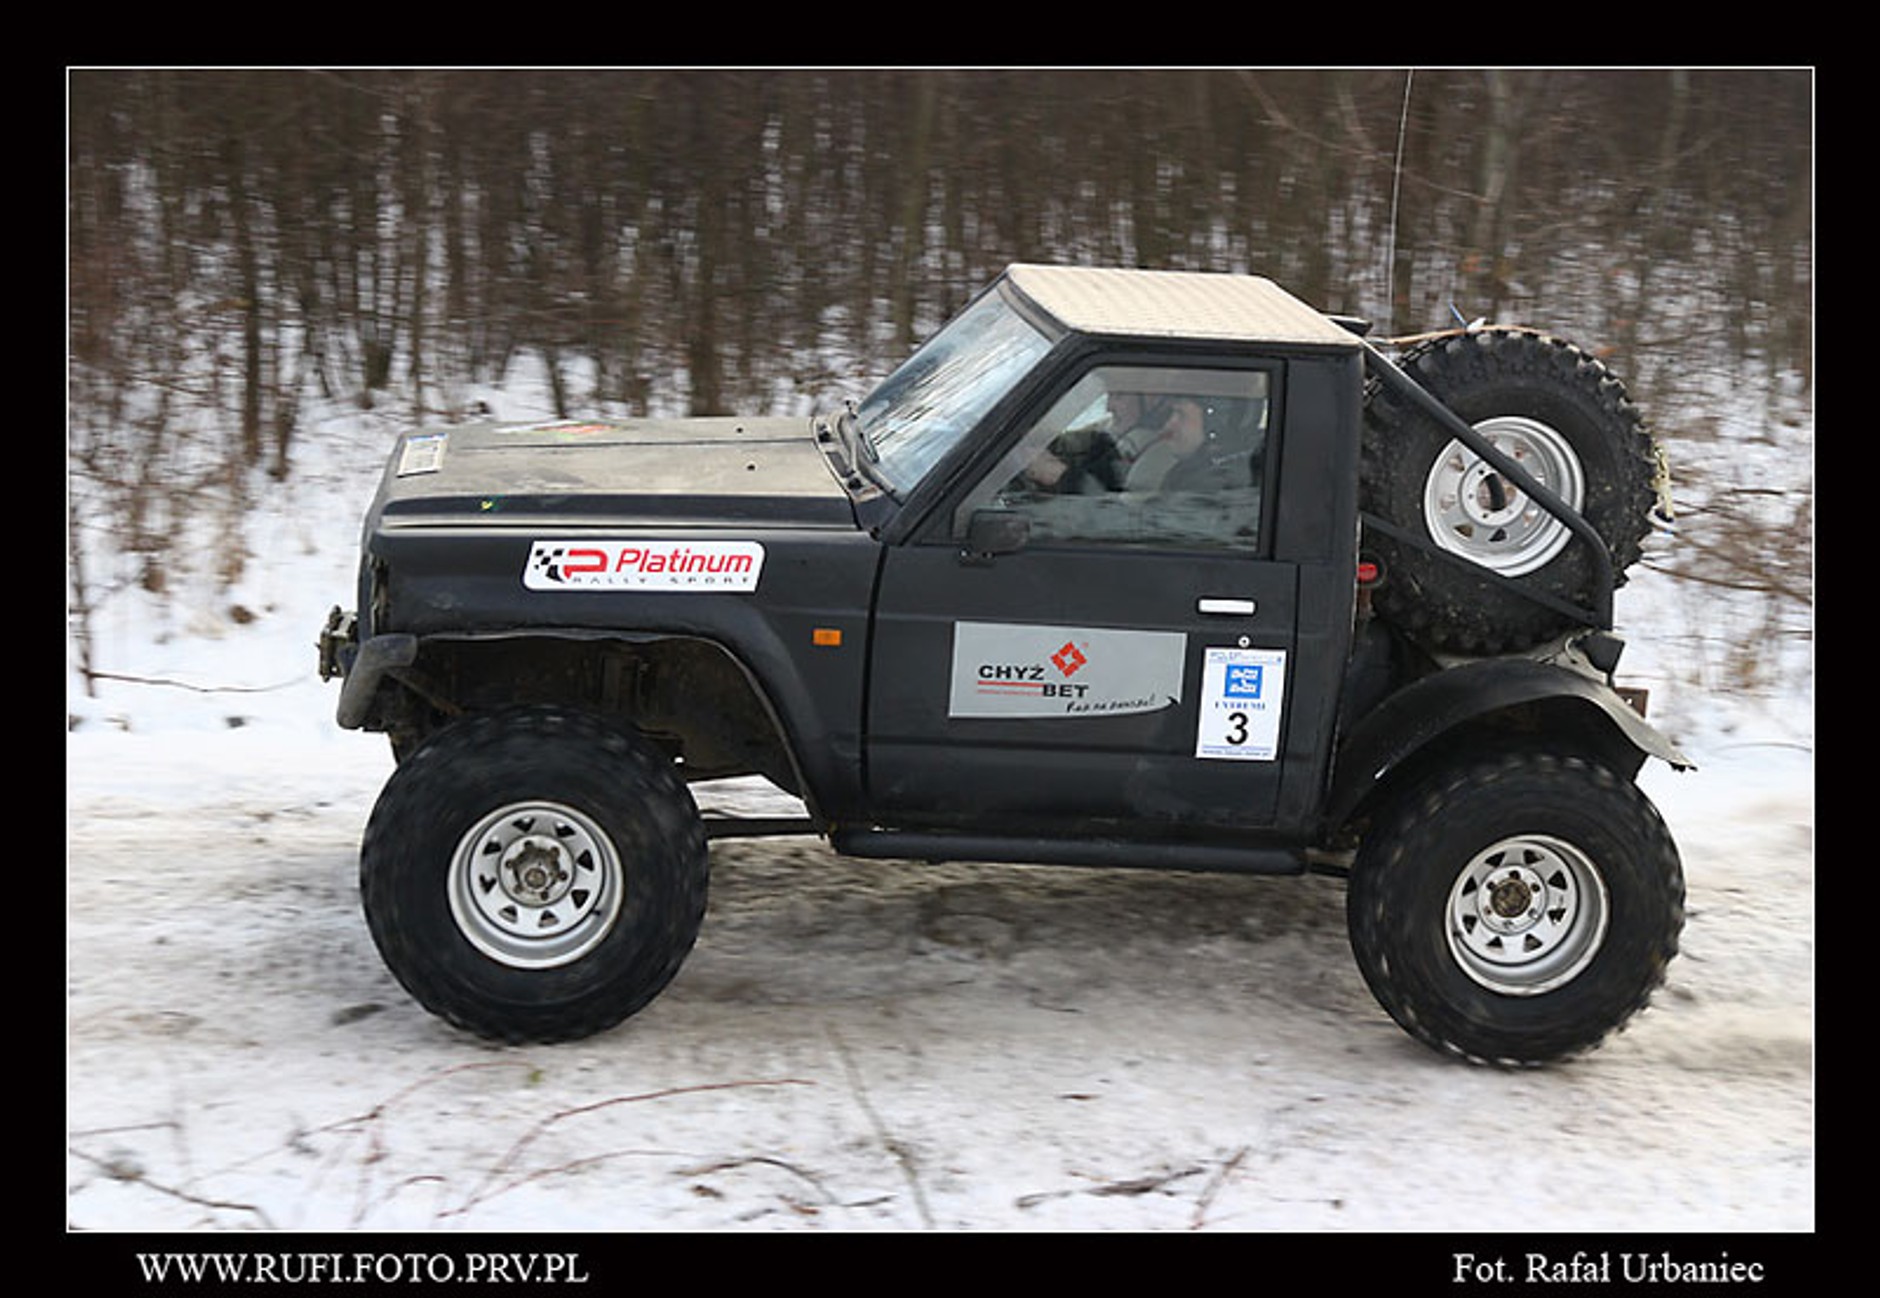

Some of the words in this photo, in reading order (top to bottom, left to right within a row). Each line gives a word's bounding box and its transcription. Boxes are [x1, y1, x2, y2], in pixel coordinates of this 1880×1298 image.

[615, 548, 753, 573] Platinum
[669, 576, 749, 584] SPORT
[978, 664, 1045, 681] CHYŻ
[1042, 684, 1089, 698] BET
[1225, 711, 1249, 746] 3
